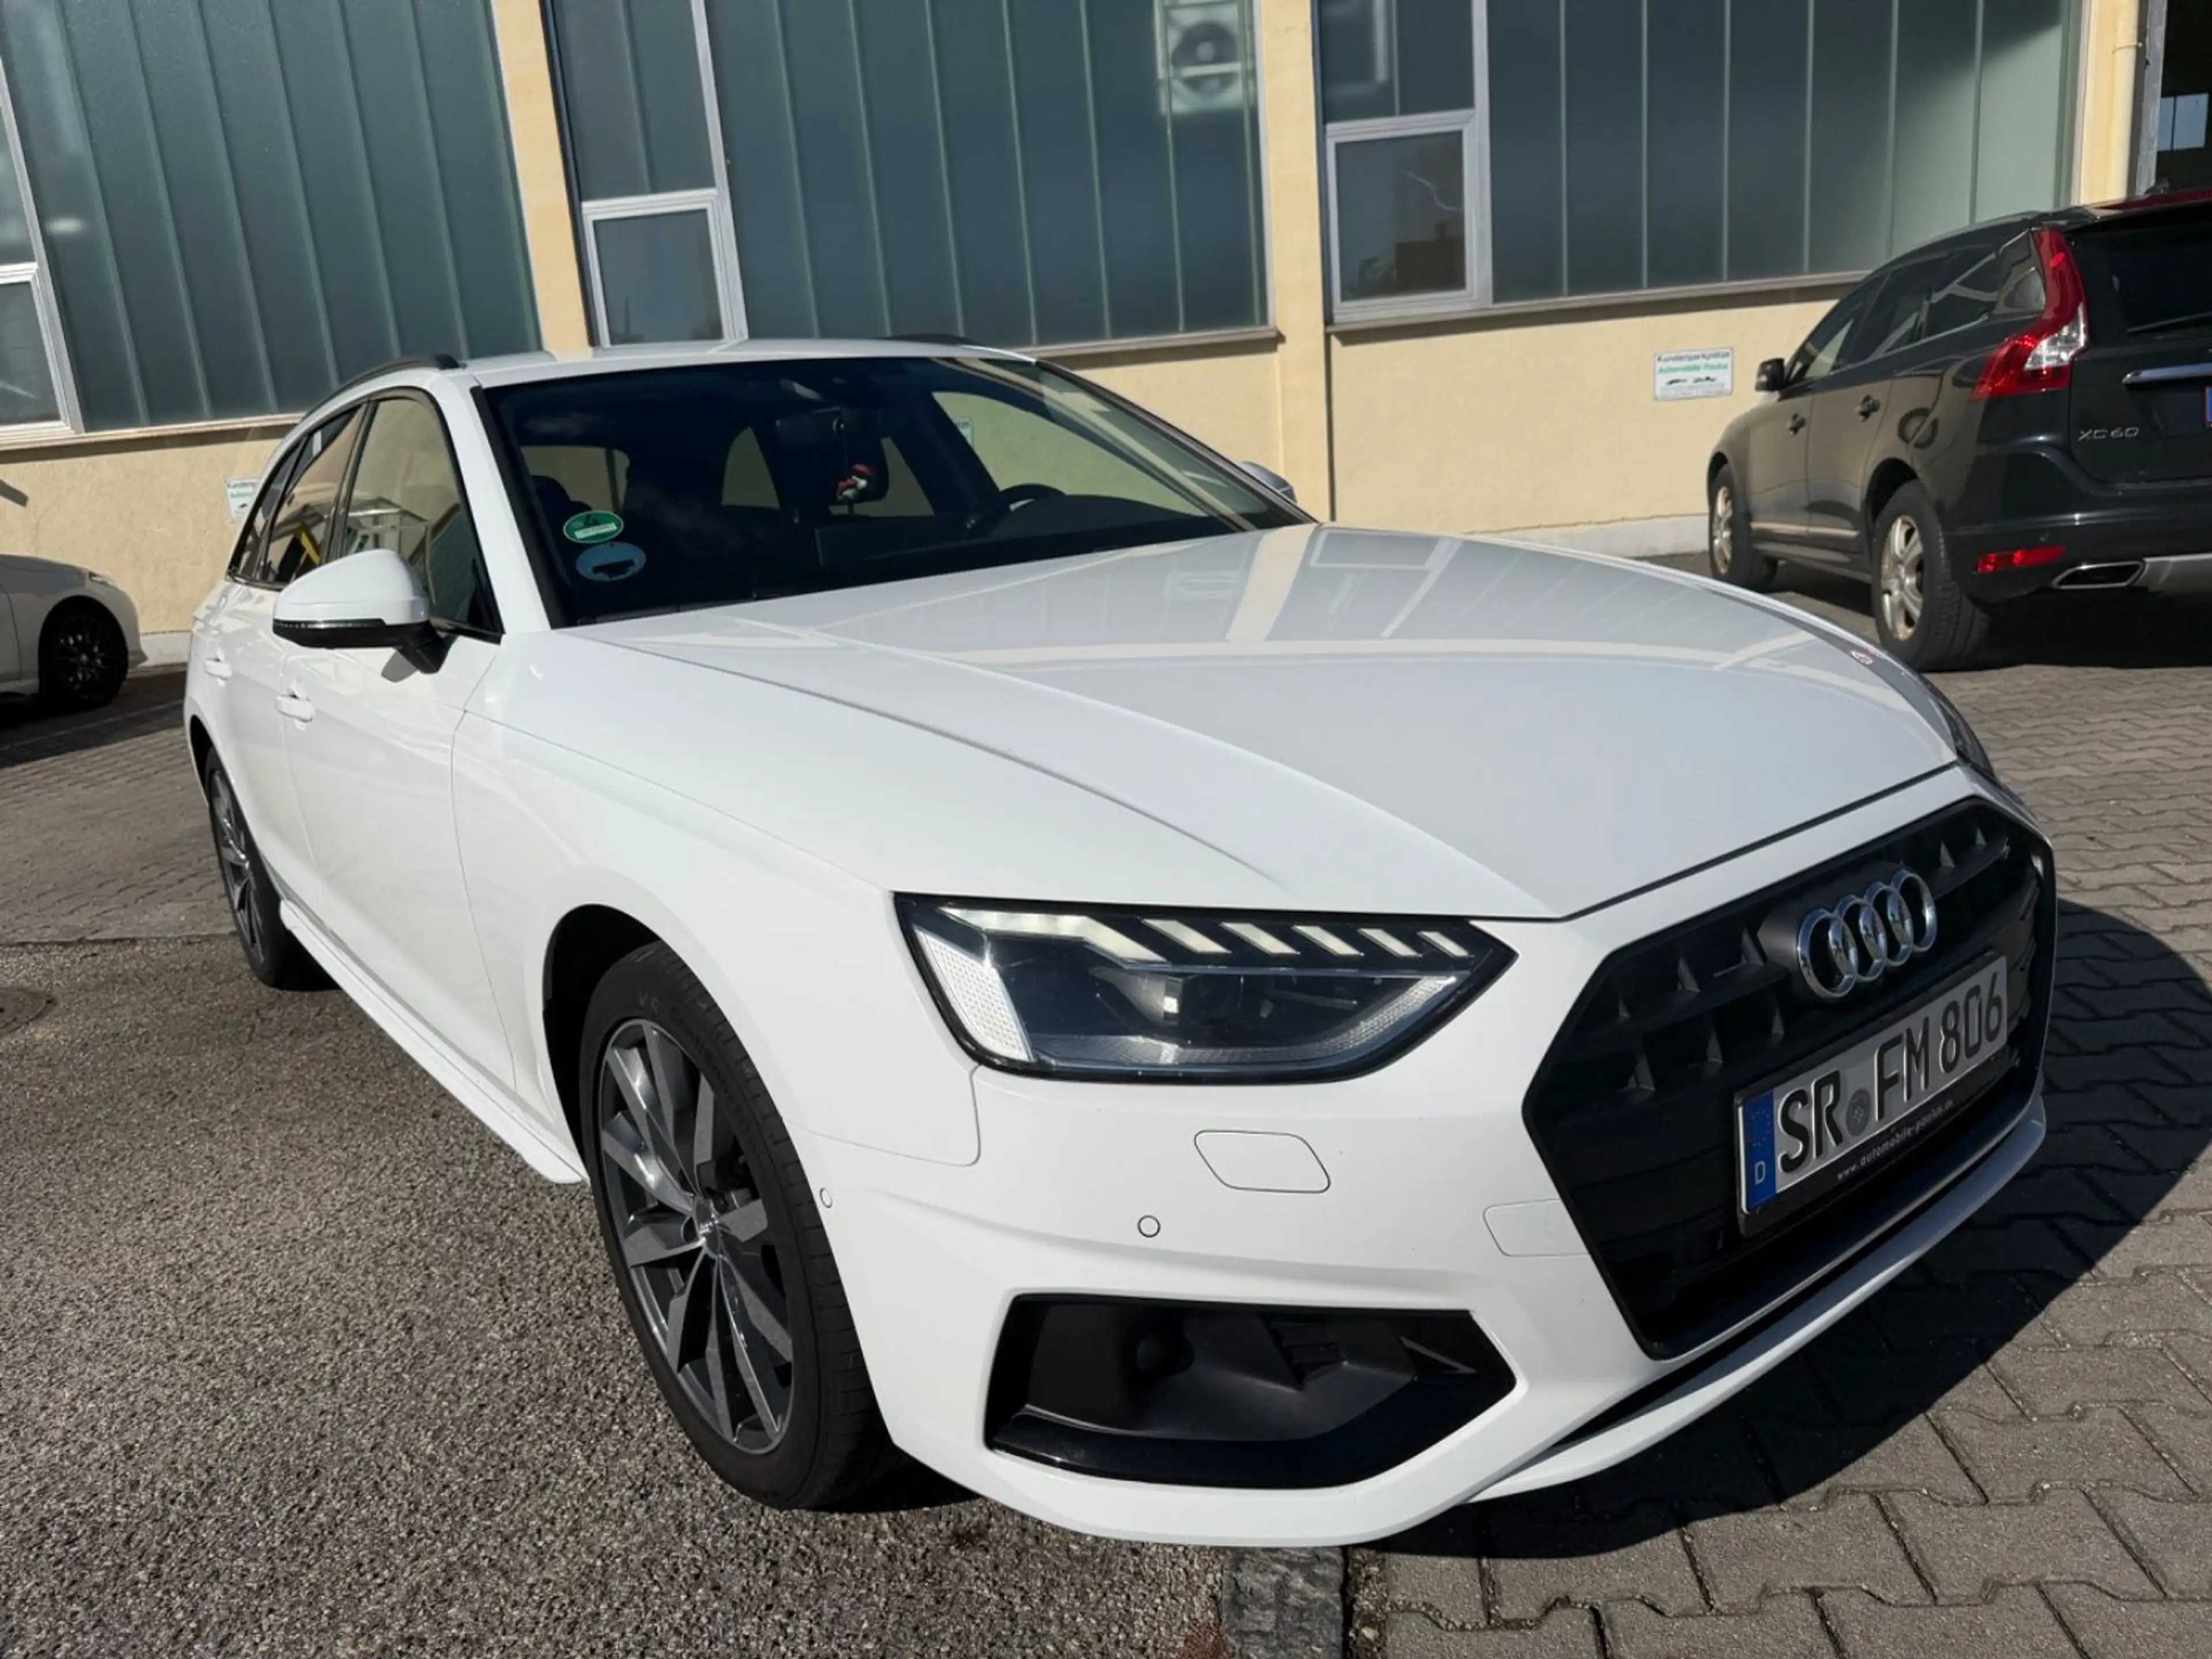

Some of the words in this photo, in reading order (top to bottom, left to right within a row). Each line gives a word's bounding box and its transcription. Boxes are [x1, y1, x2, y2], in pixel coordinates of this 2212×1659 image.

[2078, 427, 2139, 441] XC60
[1778, 1070, 1843, 1173] SR
[1874, 1017, 1929, 1122] FM
[1940, 972, 2003, 1074] 806
[1755, 1160, 1766, 1185] D
